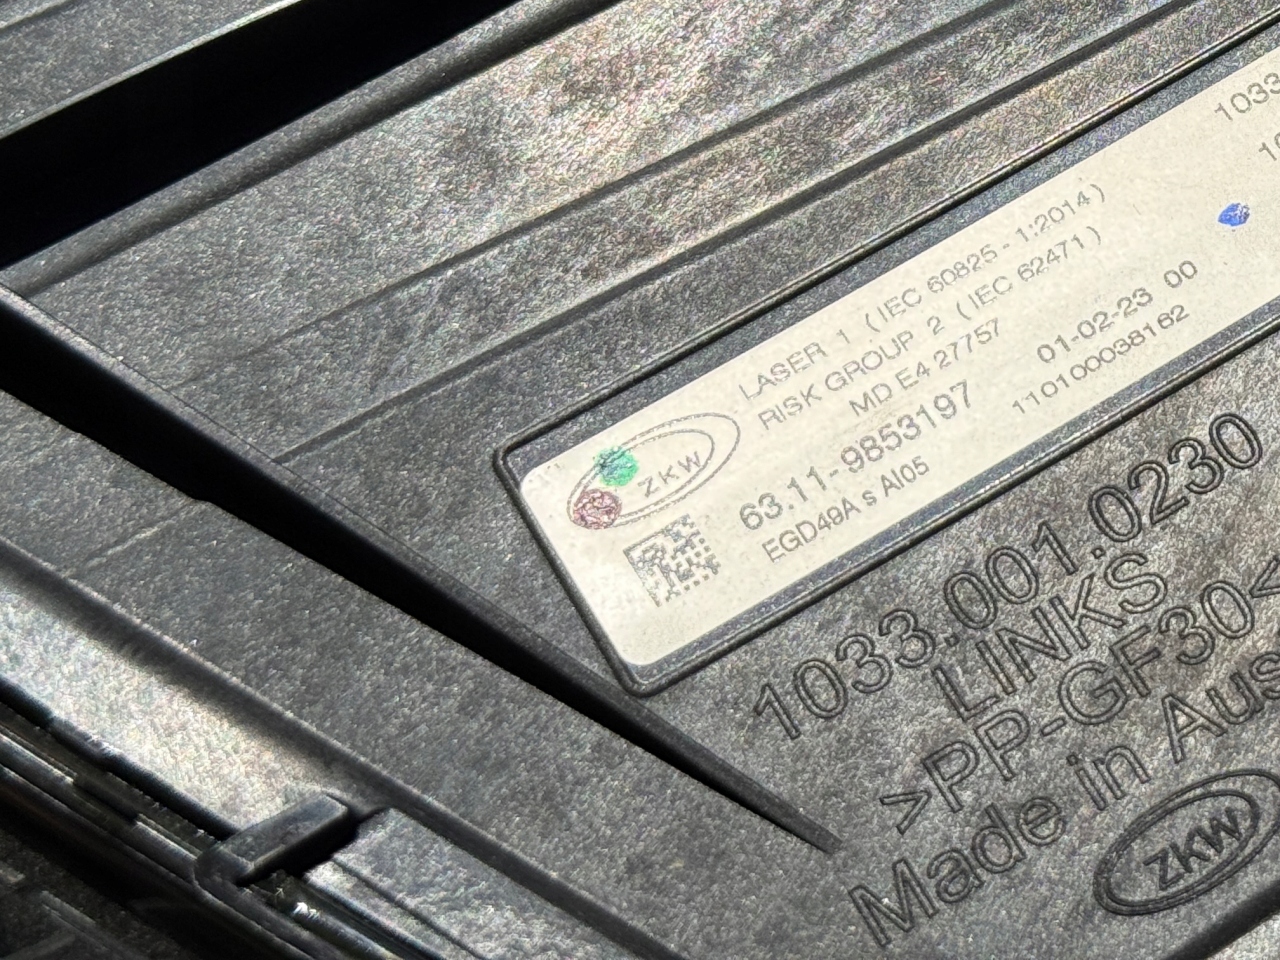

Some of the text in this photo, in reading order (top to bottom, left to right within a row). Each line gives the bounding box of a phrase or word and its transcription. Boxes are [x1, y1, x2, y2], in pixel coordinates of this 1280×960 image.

[738, 340, 825, 401] LASER
[925, 244, 999, 298] 60825
[849, 318, 1001, 418] MD E4 27757
[1010, 304, 1190, 416] 110100038162
[1036, 259, 1198, 365] 01-02-23 00
[757, 382, 821, 432] RISK
[824, 331, 916, 392] GROUP
[926, 315, 944, 336] 2
[638, 450, 704, 496] ZKW
[739, 381, 974, 531] 63.11-9853197
[753, 412, 1264, 741] 1033.001.0230
[931, 550, 1169, 724] LINKS
[848, 794, 1066, 949] Made
[1066, 741, 1150, 811] in
[1142, 808, 1241, 890] ZKW
